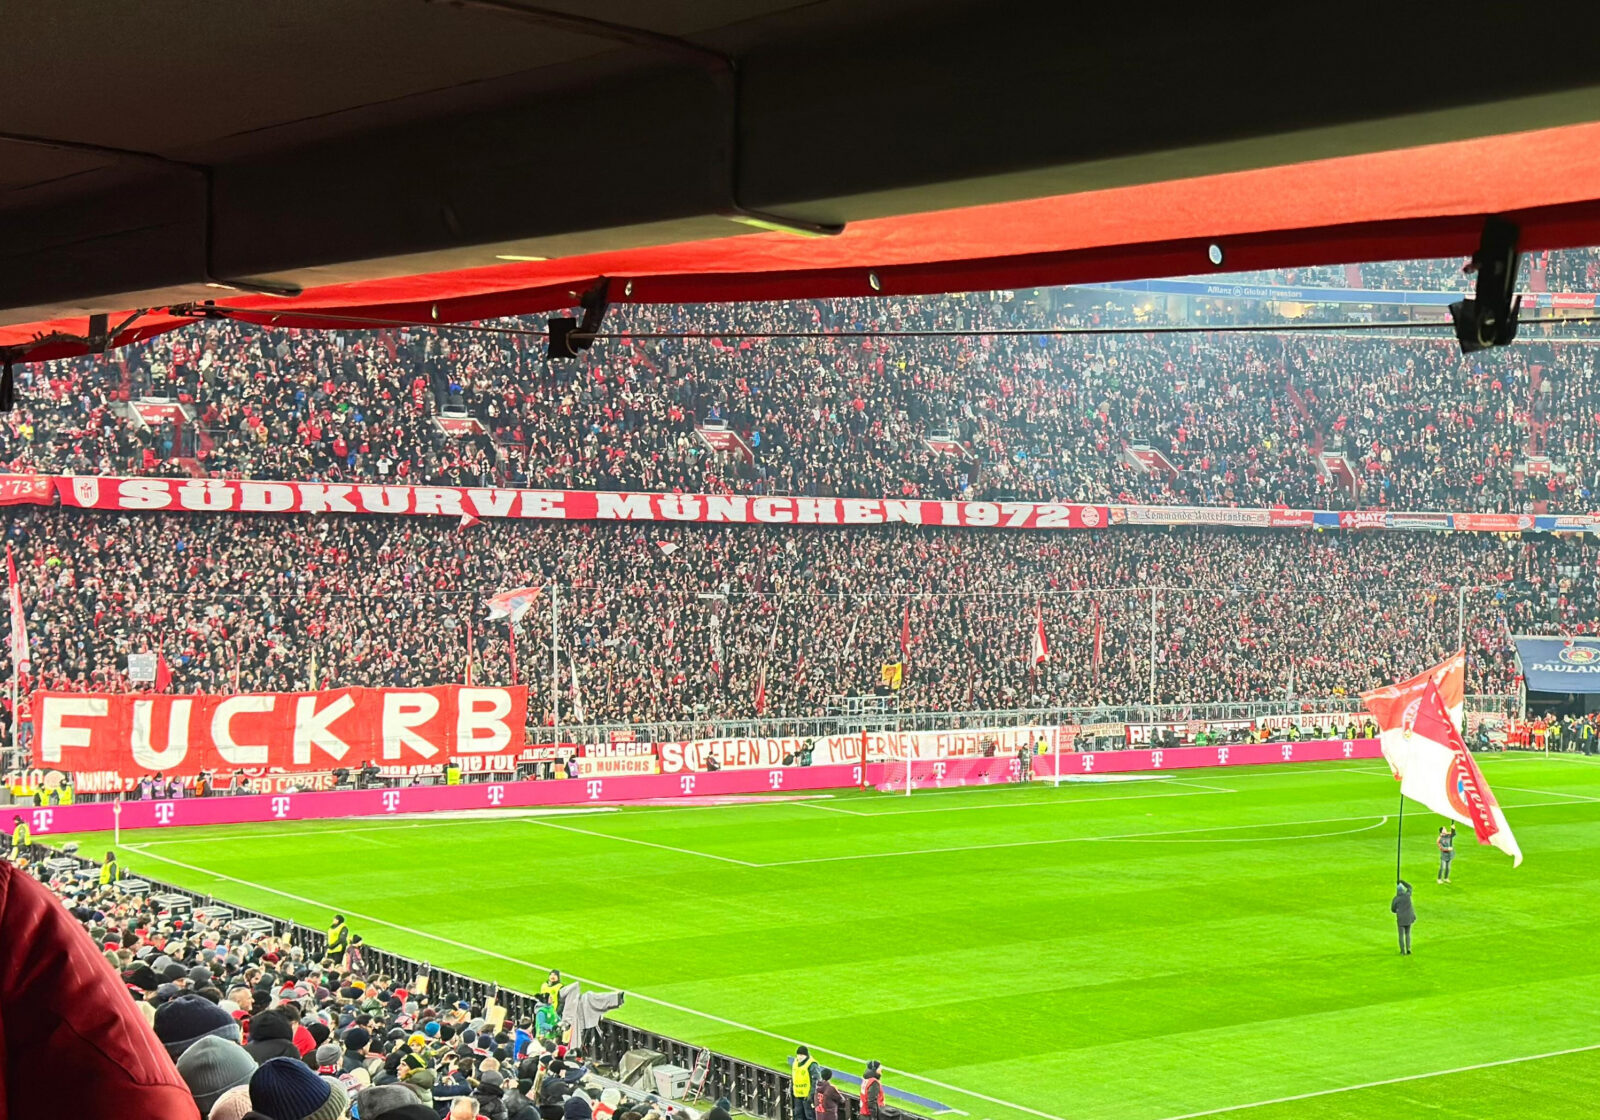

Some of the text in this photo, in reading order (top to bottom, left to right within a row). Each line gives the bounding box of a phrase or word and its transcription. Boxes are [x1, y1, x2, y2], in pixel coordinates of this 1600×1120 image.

[1207, 286, 1302, 298] Allianz Global Investors
[118, 479, 1071, 528] SÜDKURVE MÜNCHEN 1972
[1301, 715, 1345, 728] BRETTEN
[578, 763, 592, 774] ED
